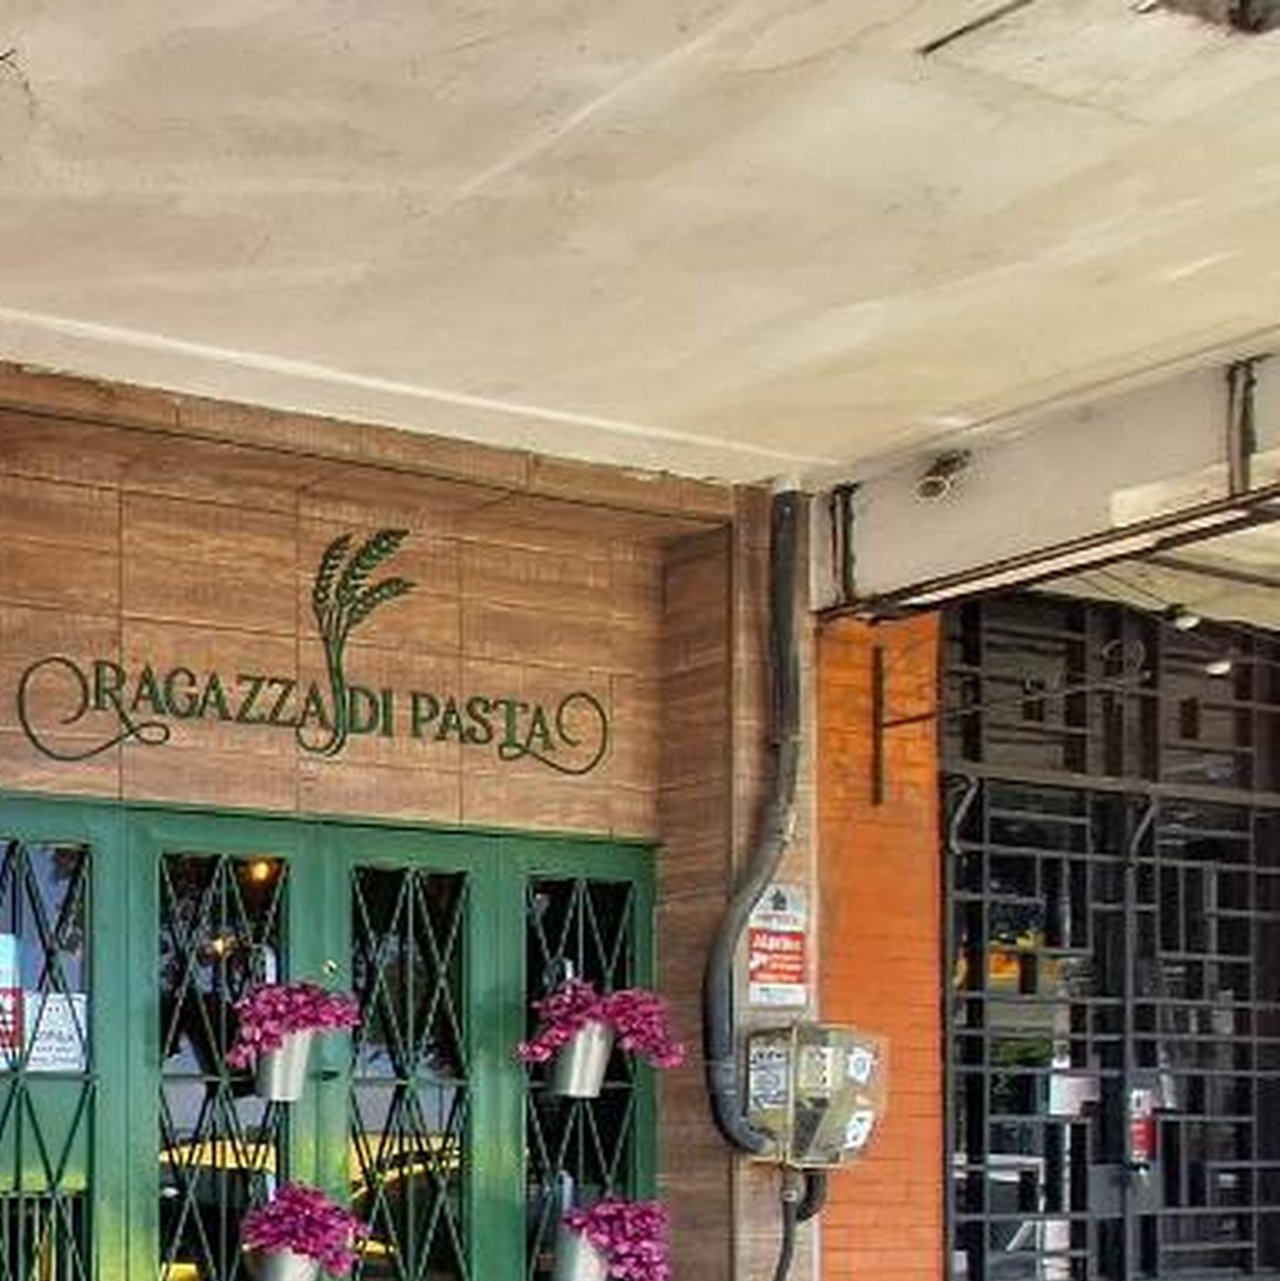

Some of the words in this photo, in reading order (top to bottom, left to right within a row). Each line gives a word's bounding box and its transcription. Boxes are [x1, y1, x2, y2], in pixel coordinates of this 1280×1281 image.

[88, 656, 343, 752] RAGAZZA
[344, 684, 393, 738] DI
[409, 690, 570, 768] PASTA
